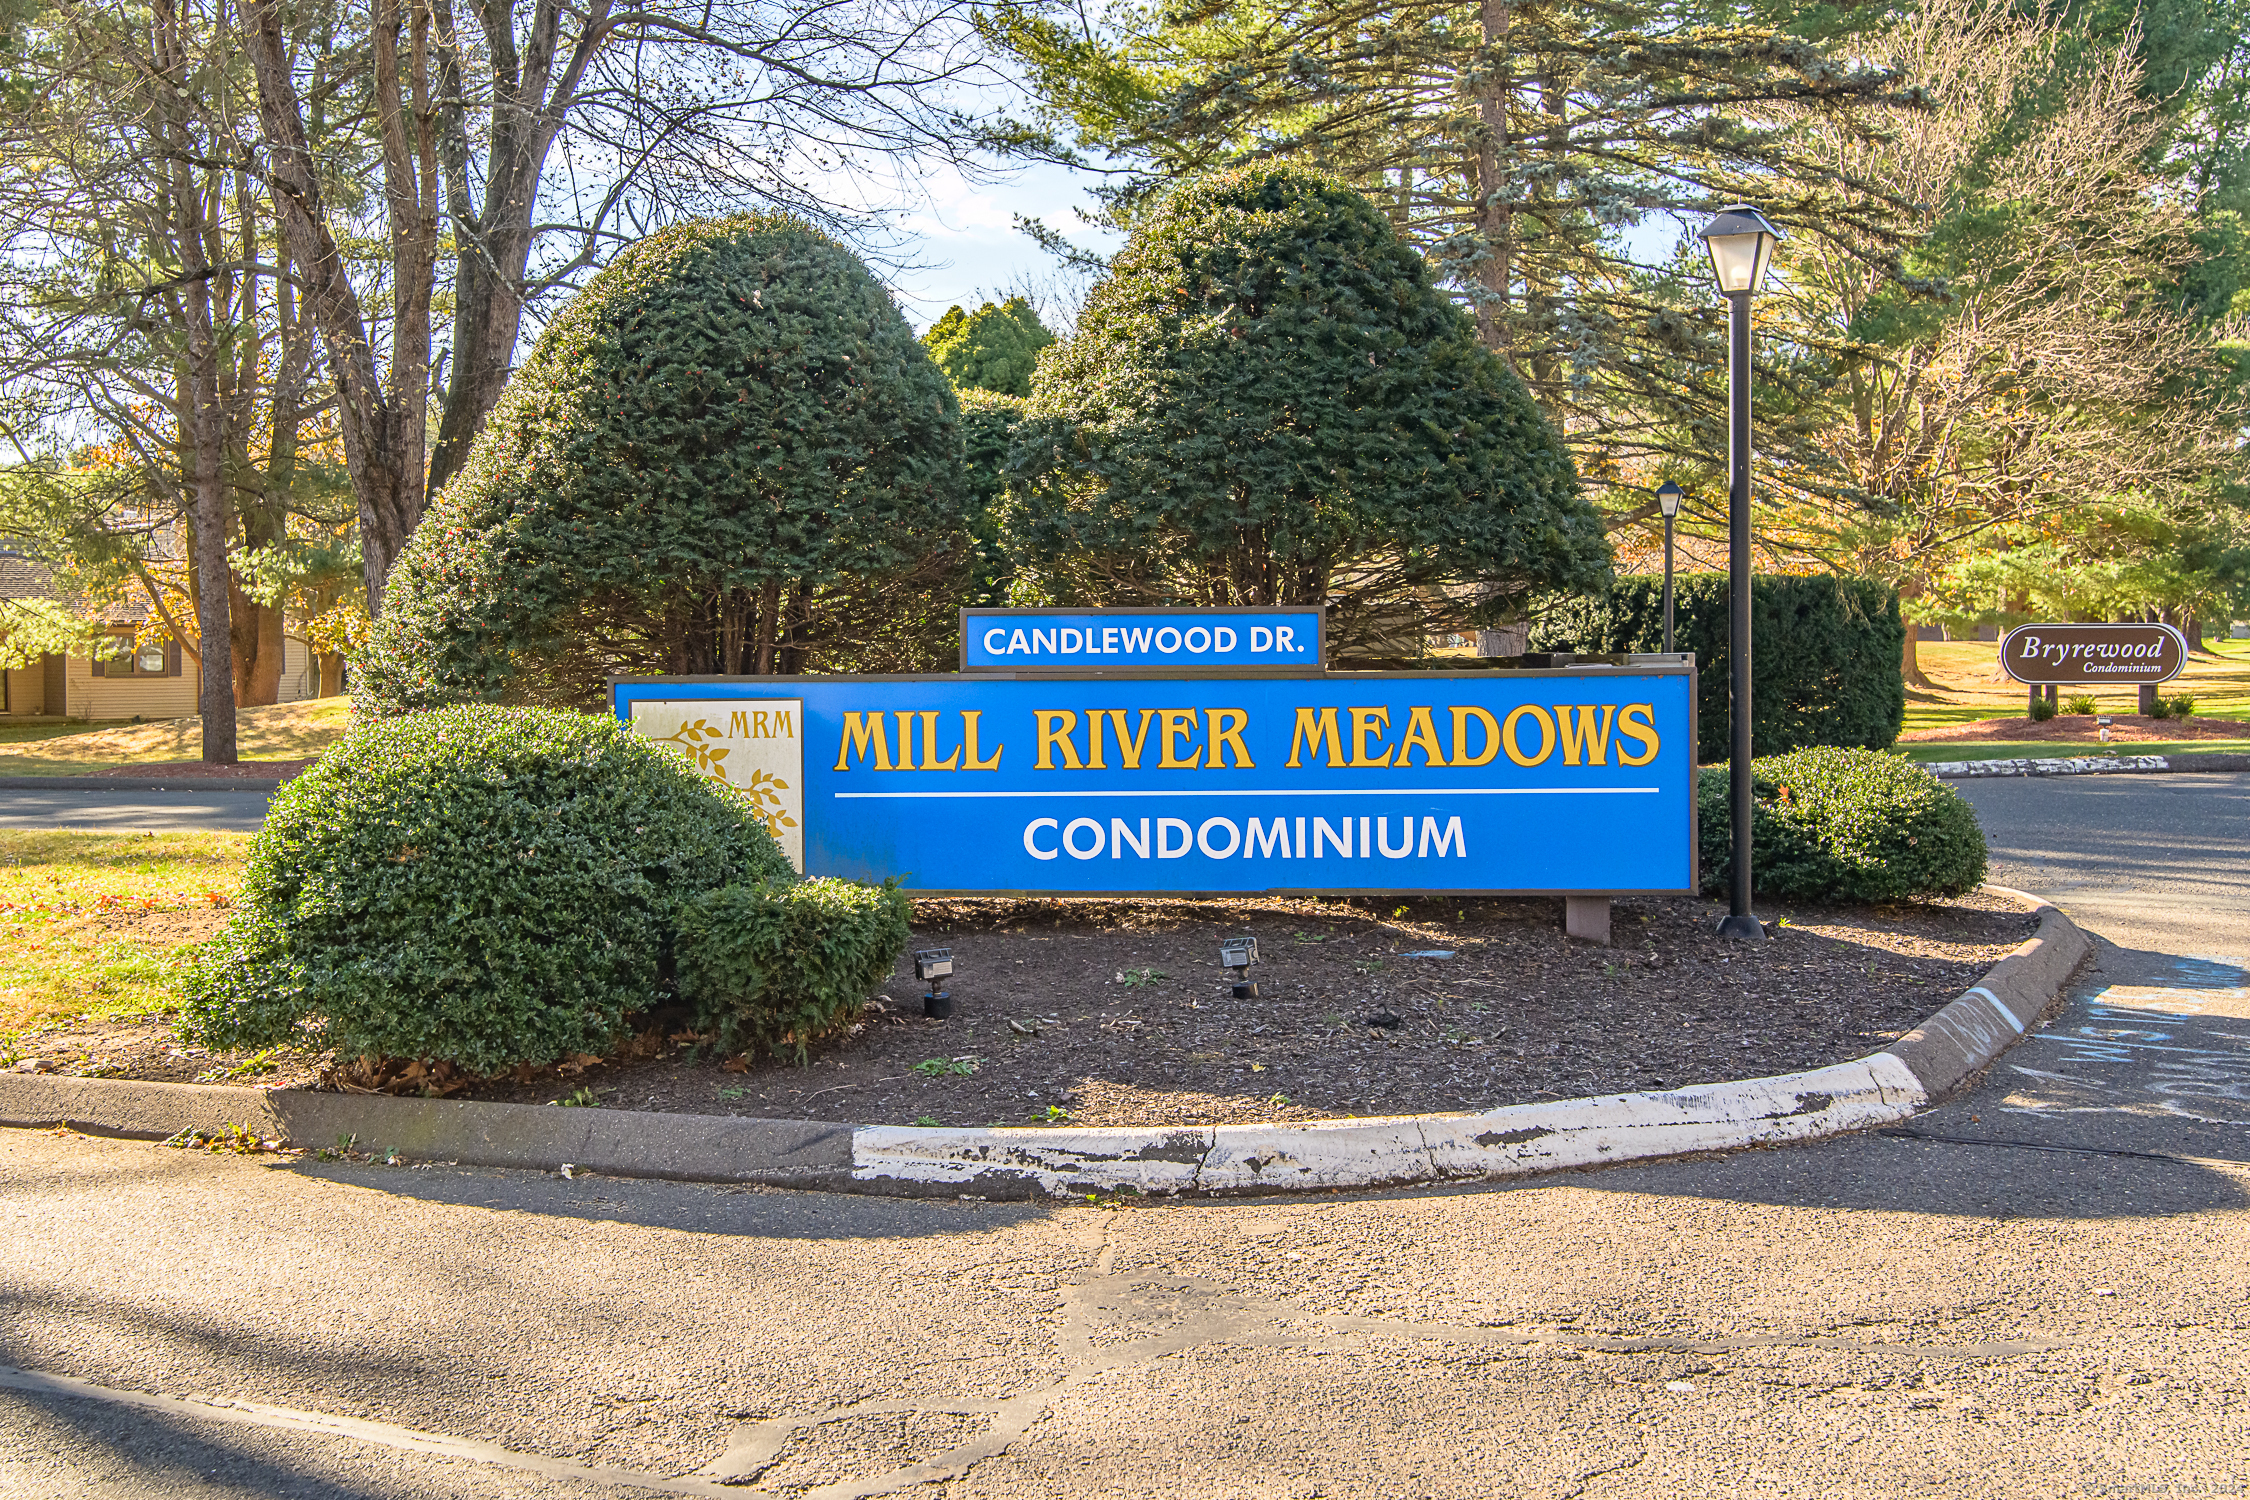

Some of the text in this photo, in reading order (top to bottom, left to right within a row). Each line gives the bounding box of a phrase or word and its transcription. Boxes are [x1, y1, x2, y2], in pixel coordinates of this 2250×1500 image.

[983, 626, 1305, 655] CANDLEWOOD DR.
[2020, 636, 2165, 667] Bryrewood
[2083, 662, 2162, 673] Condominium
[728, 710, 794, 740] MRM
[833, 703, 1661, 773] MILL RIVER MEADOWS
[1023, 816, 1467, 860] CONDOMINIUM
